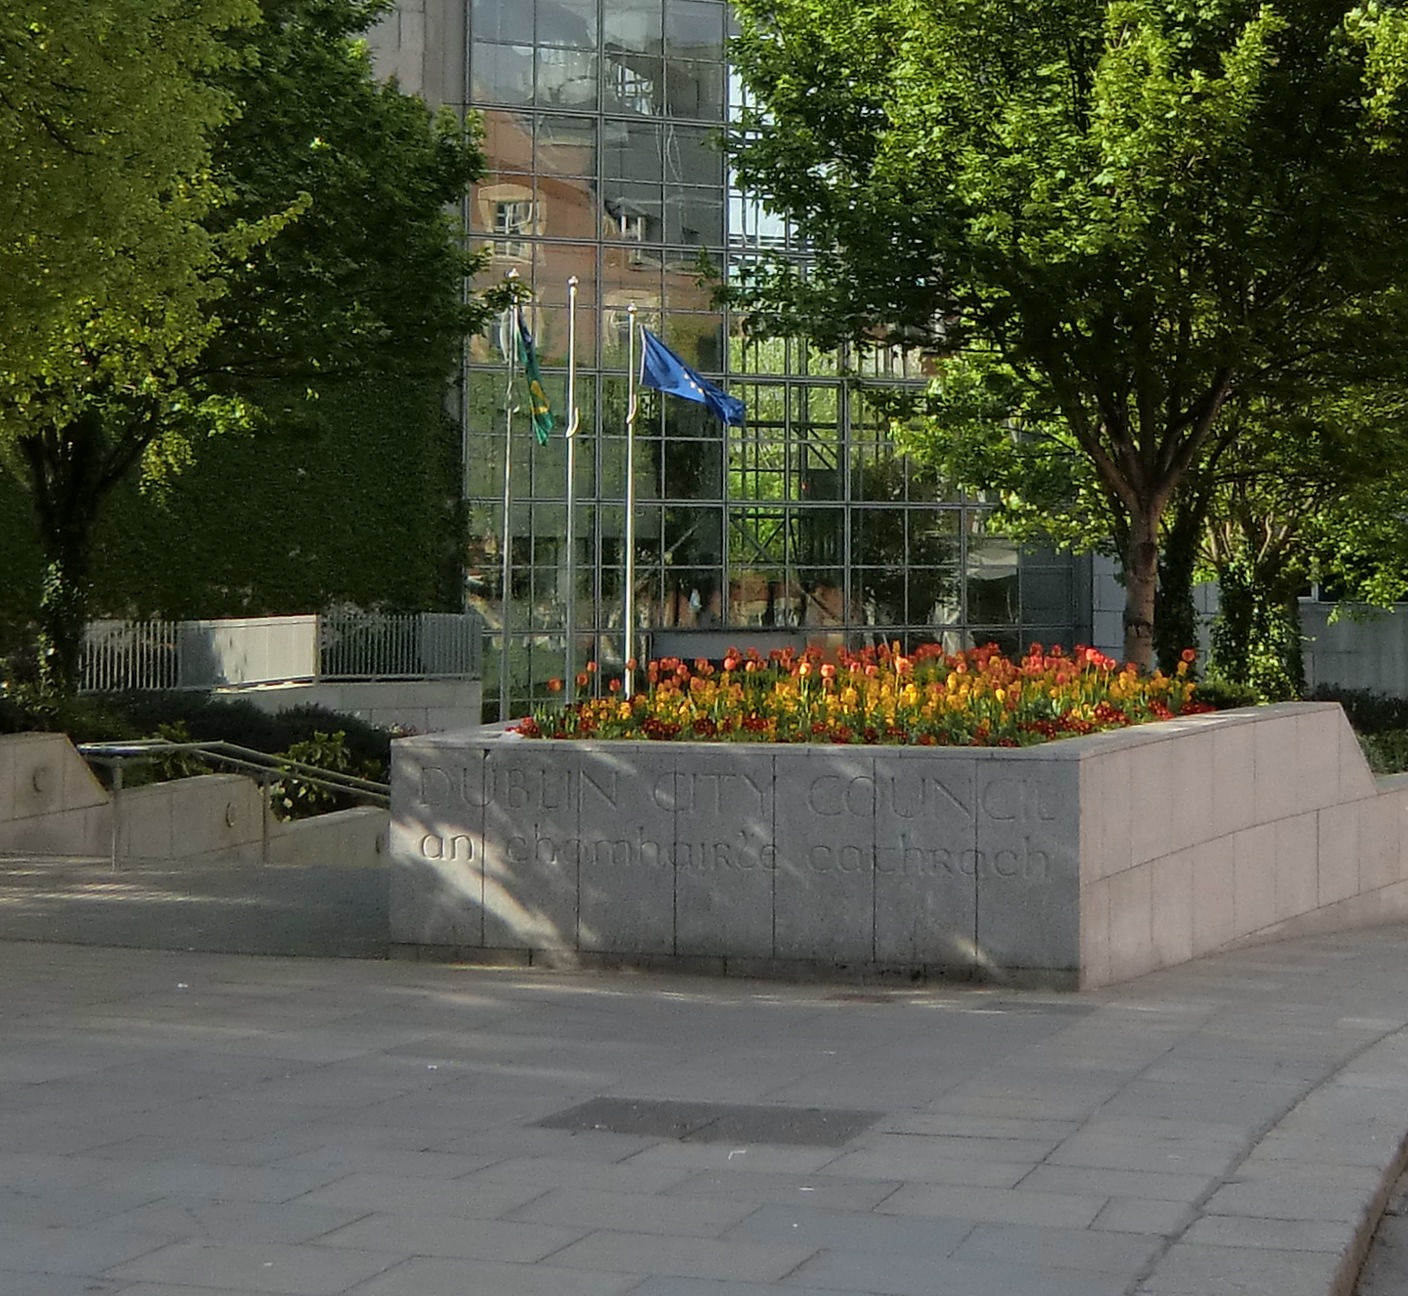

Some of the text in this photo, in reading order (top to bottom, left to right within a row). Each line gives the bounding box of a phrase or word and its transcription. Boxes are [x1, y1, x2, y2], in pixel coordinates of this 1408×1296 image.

[419, 765, 1057, 822] DUBLIN CITY COUNCIL
[419, 832, 476, 863] an
